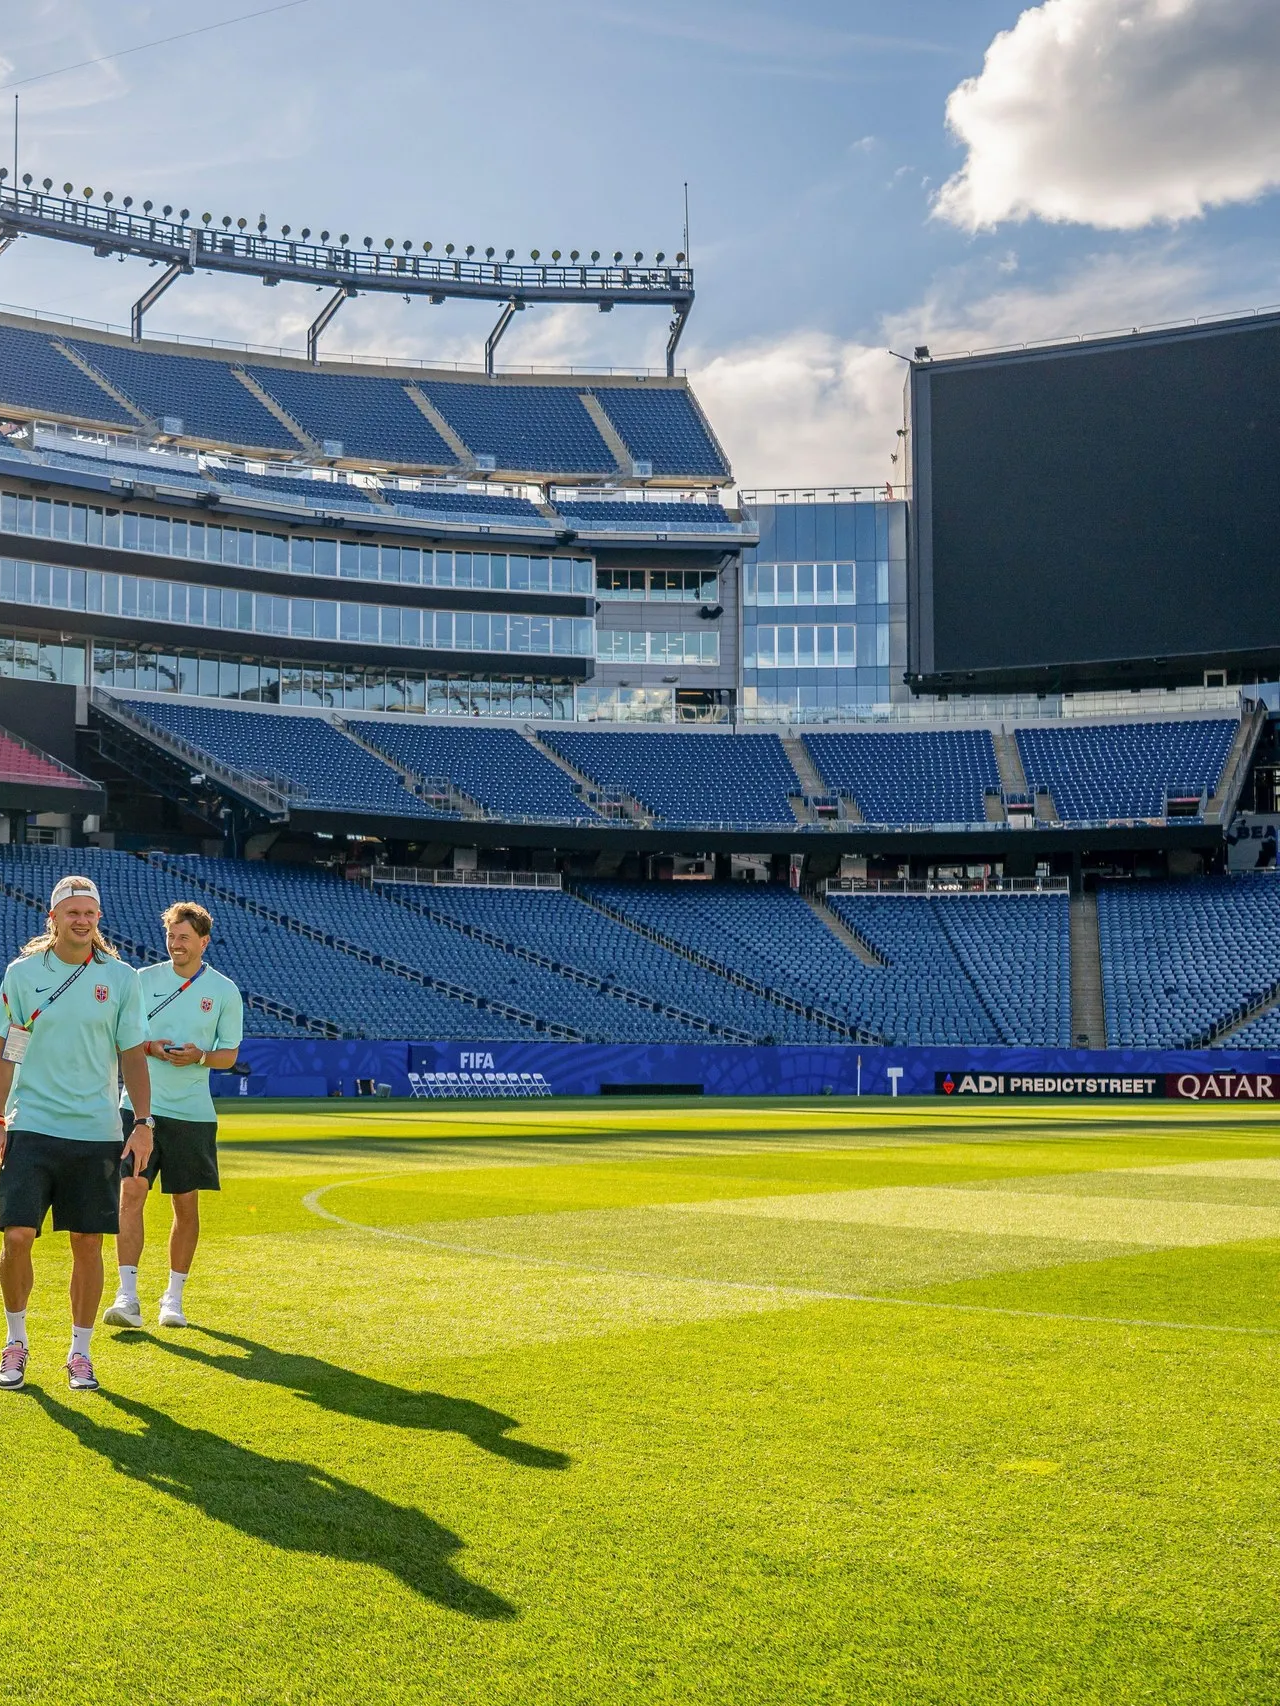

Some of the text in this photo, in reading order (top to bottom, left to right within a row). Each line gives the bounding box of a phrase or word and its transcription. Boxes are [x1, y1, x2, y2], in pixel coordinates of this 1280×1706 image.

[460, 1052, 495, 1069] FIFA
[958, 1075, 1156, 1094] ADI PREDICTSTREET
[1177, 1074, 1274, 1100] QATAR
